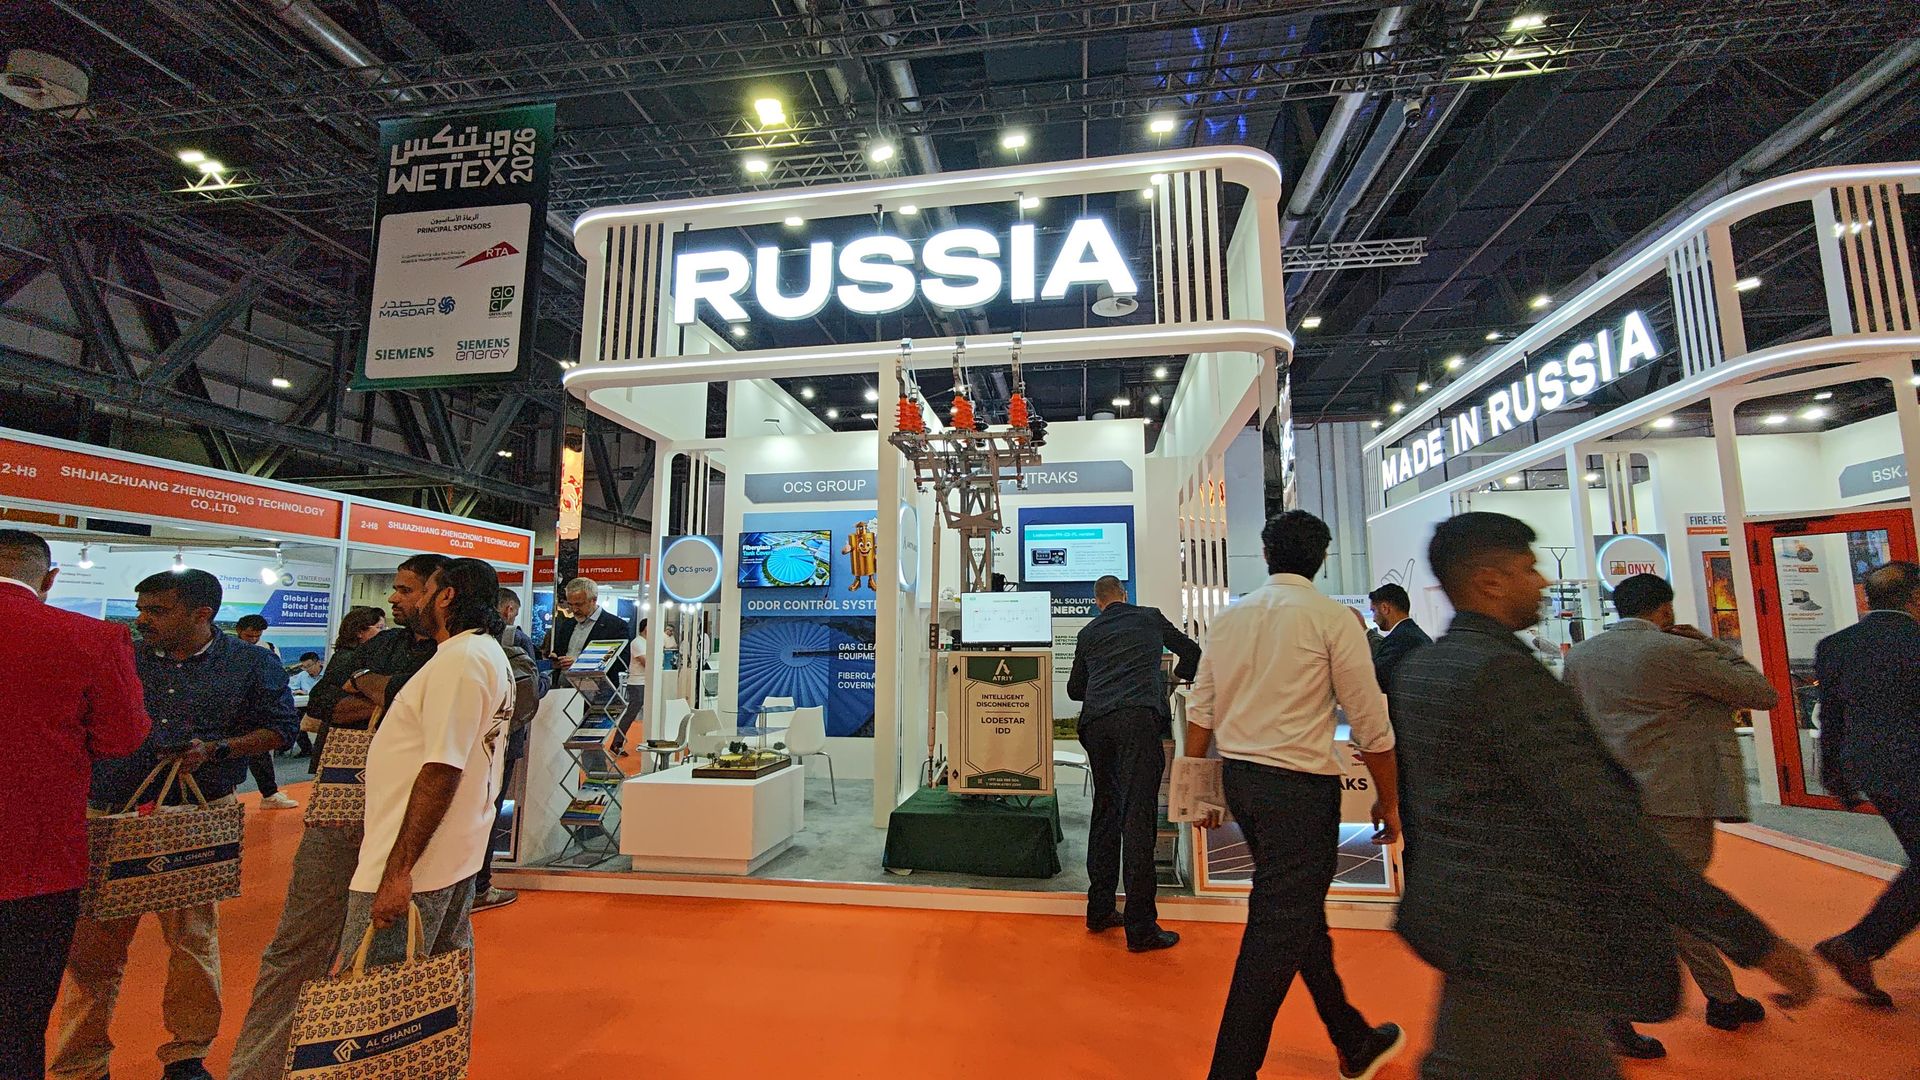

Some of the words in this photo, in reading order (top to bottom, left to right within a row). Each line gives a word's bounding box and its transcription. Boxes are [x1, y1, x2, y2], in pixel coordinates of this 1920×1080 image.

[510, 127, 537, 184] 2026
[386, 157, 507, 195] WETEX
[417, 224, 452, 234] PRINCIPAL
[453, 222, 491, 232] SPONSORS
[486, 247, 509, 257] RTA
[674, 218, 1139, 326] RUSSIA
[379, 308, 435, 318] MASDAR
[456, 338, 510, 350] SIEMENS
[375, 347, 434, 360] SIEMENS
[1381, 427, 1446, 491] MADE
[1451, 405, 1483, 456] IN
[1488, 309, 1663, 437] RUSSIA
[1872, 465, 1902, 483] BSK
[1, 462, 37, 478] 2-H8
[60, 465, 169, 492] SHIJIAZHUANG
[172, 483, 254, 506] ZHENGZHONG
[257, 497, 325, 518] TECHNOLOGY
[783, 481, 812, 493] OCS
[816, 479, 866, 492] GROUP
[190, 499, 239, 515] CO.,LTD.
[361, 520, 378, 530] 2-H8
[388, 521, 440, 536] SHIJIAZHUANG
[440, 529, 483, 543] ZHENGZHONG
[484, 536, 520, 549] TECHNOLOGY
[694, 566, 713, 574] group
[1627, 563, 1656, 575] ONYX
[283, 594, 309, 602] Global
[282, 602, 308, 610] Bolted
[747, 600, 780, 611] ODOR
[783, 599, 840, 610] CONTROL
[838, 643, 856, 651] GAS
[981, 717, 1025, 725] LODESTAR
[995, 727, 1011, 735] IDD
[366, 1038, 380, 1049] AL
[381, 1022, 422, 1044] GHANDI
